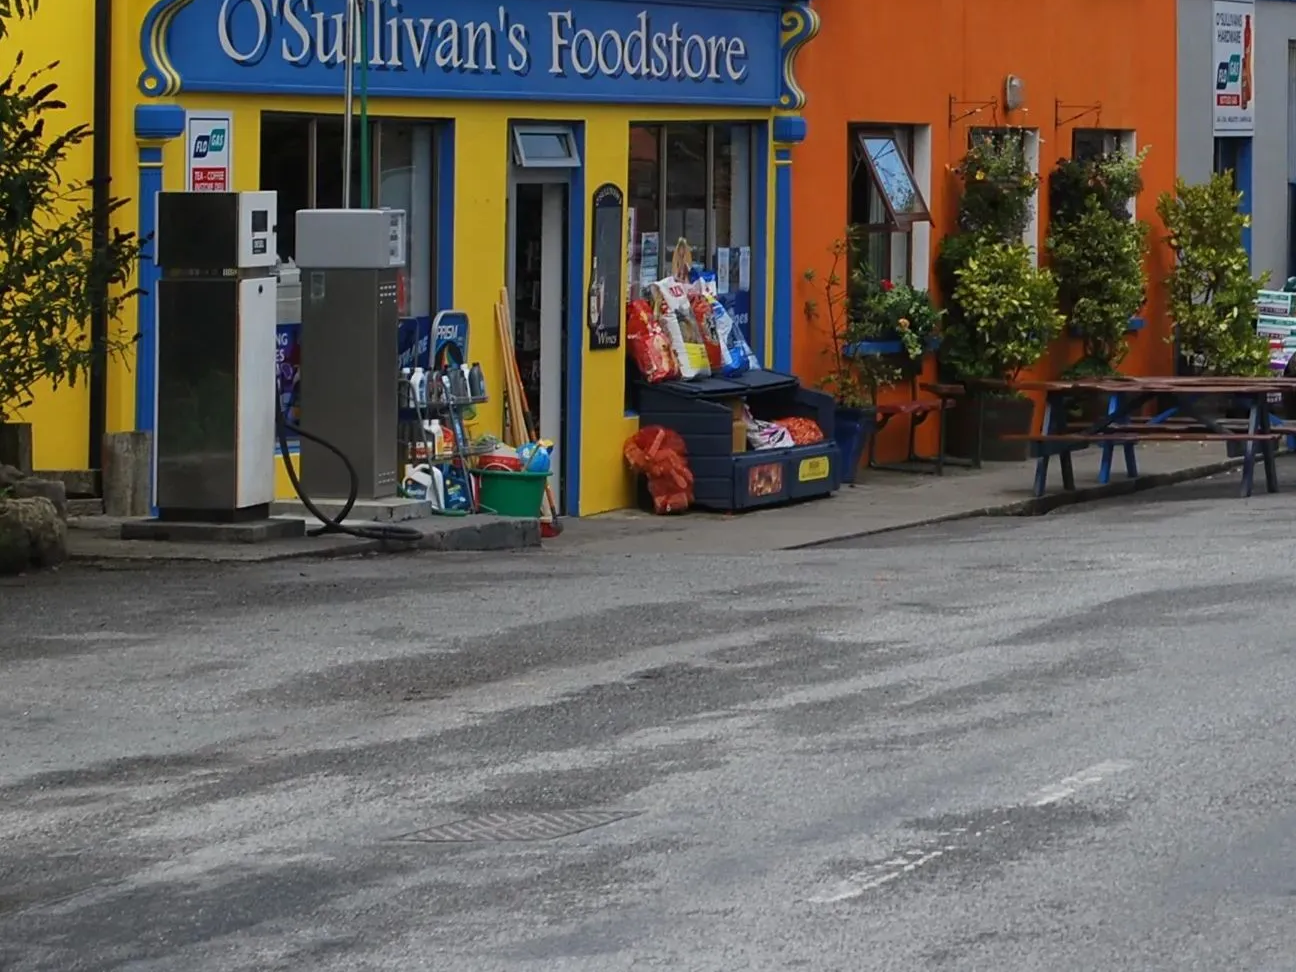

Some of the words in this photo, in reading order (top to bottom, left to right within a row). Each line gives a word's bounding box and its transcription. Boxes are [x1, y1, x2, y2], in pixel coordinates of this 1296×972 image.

[548, 10, 745, 80] Foodstore
[211, 133, 224, 146] GAS
[195, 140, 208, 153] FLO
[194, 171, 204, 181] TEA
[207, 171, 225, 181] COFFEE
